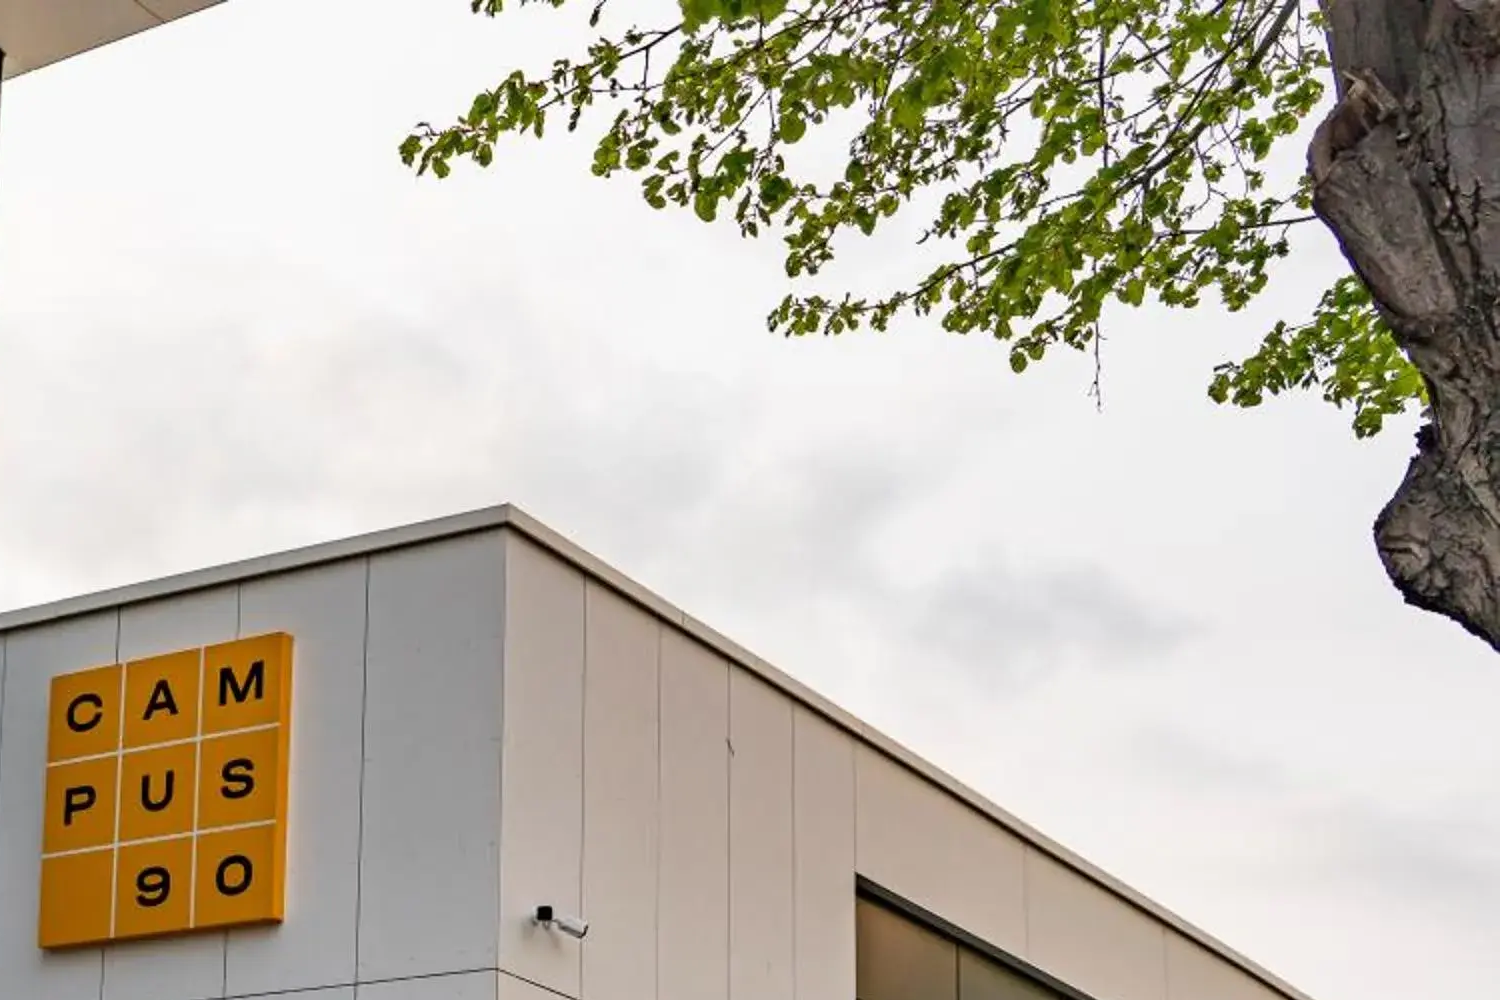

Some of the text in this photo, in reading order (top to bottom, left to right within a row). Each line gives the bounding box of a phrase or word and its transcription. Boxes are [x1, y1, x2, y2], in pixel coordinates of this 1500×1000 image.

[66, 660, 264, 733] CAM
[63, 758, 255, 827] PUS
[135, 854, 253, 908] 90
